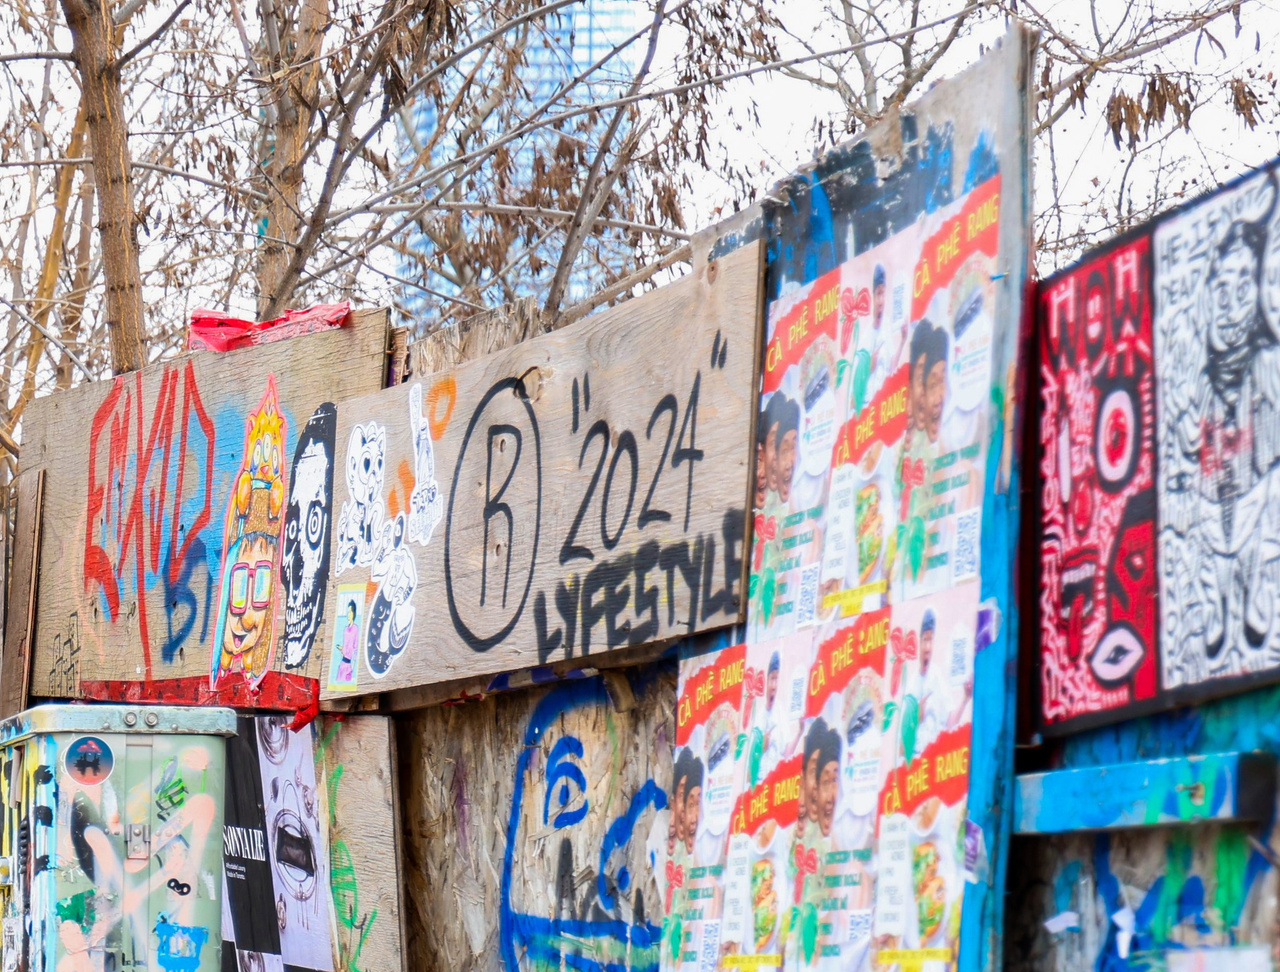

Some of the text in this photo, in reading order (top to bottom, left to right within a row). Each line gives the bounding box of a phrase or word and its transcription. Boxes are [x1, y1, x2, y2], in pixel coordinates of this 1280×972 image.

[966, 193, 999, 243] RANG
[880, 387, 908, 426] RANG
[719, 658, 746, 692] RANG
[935, 746, 969, 785] RANG
[772, 773, 802, 806] RANG
